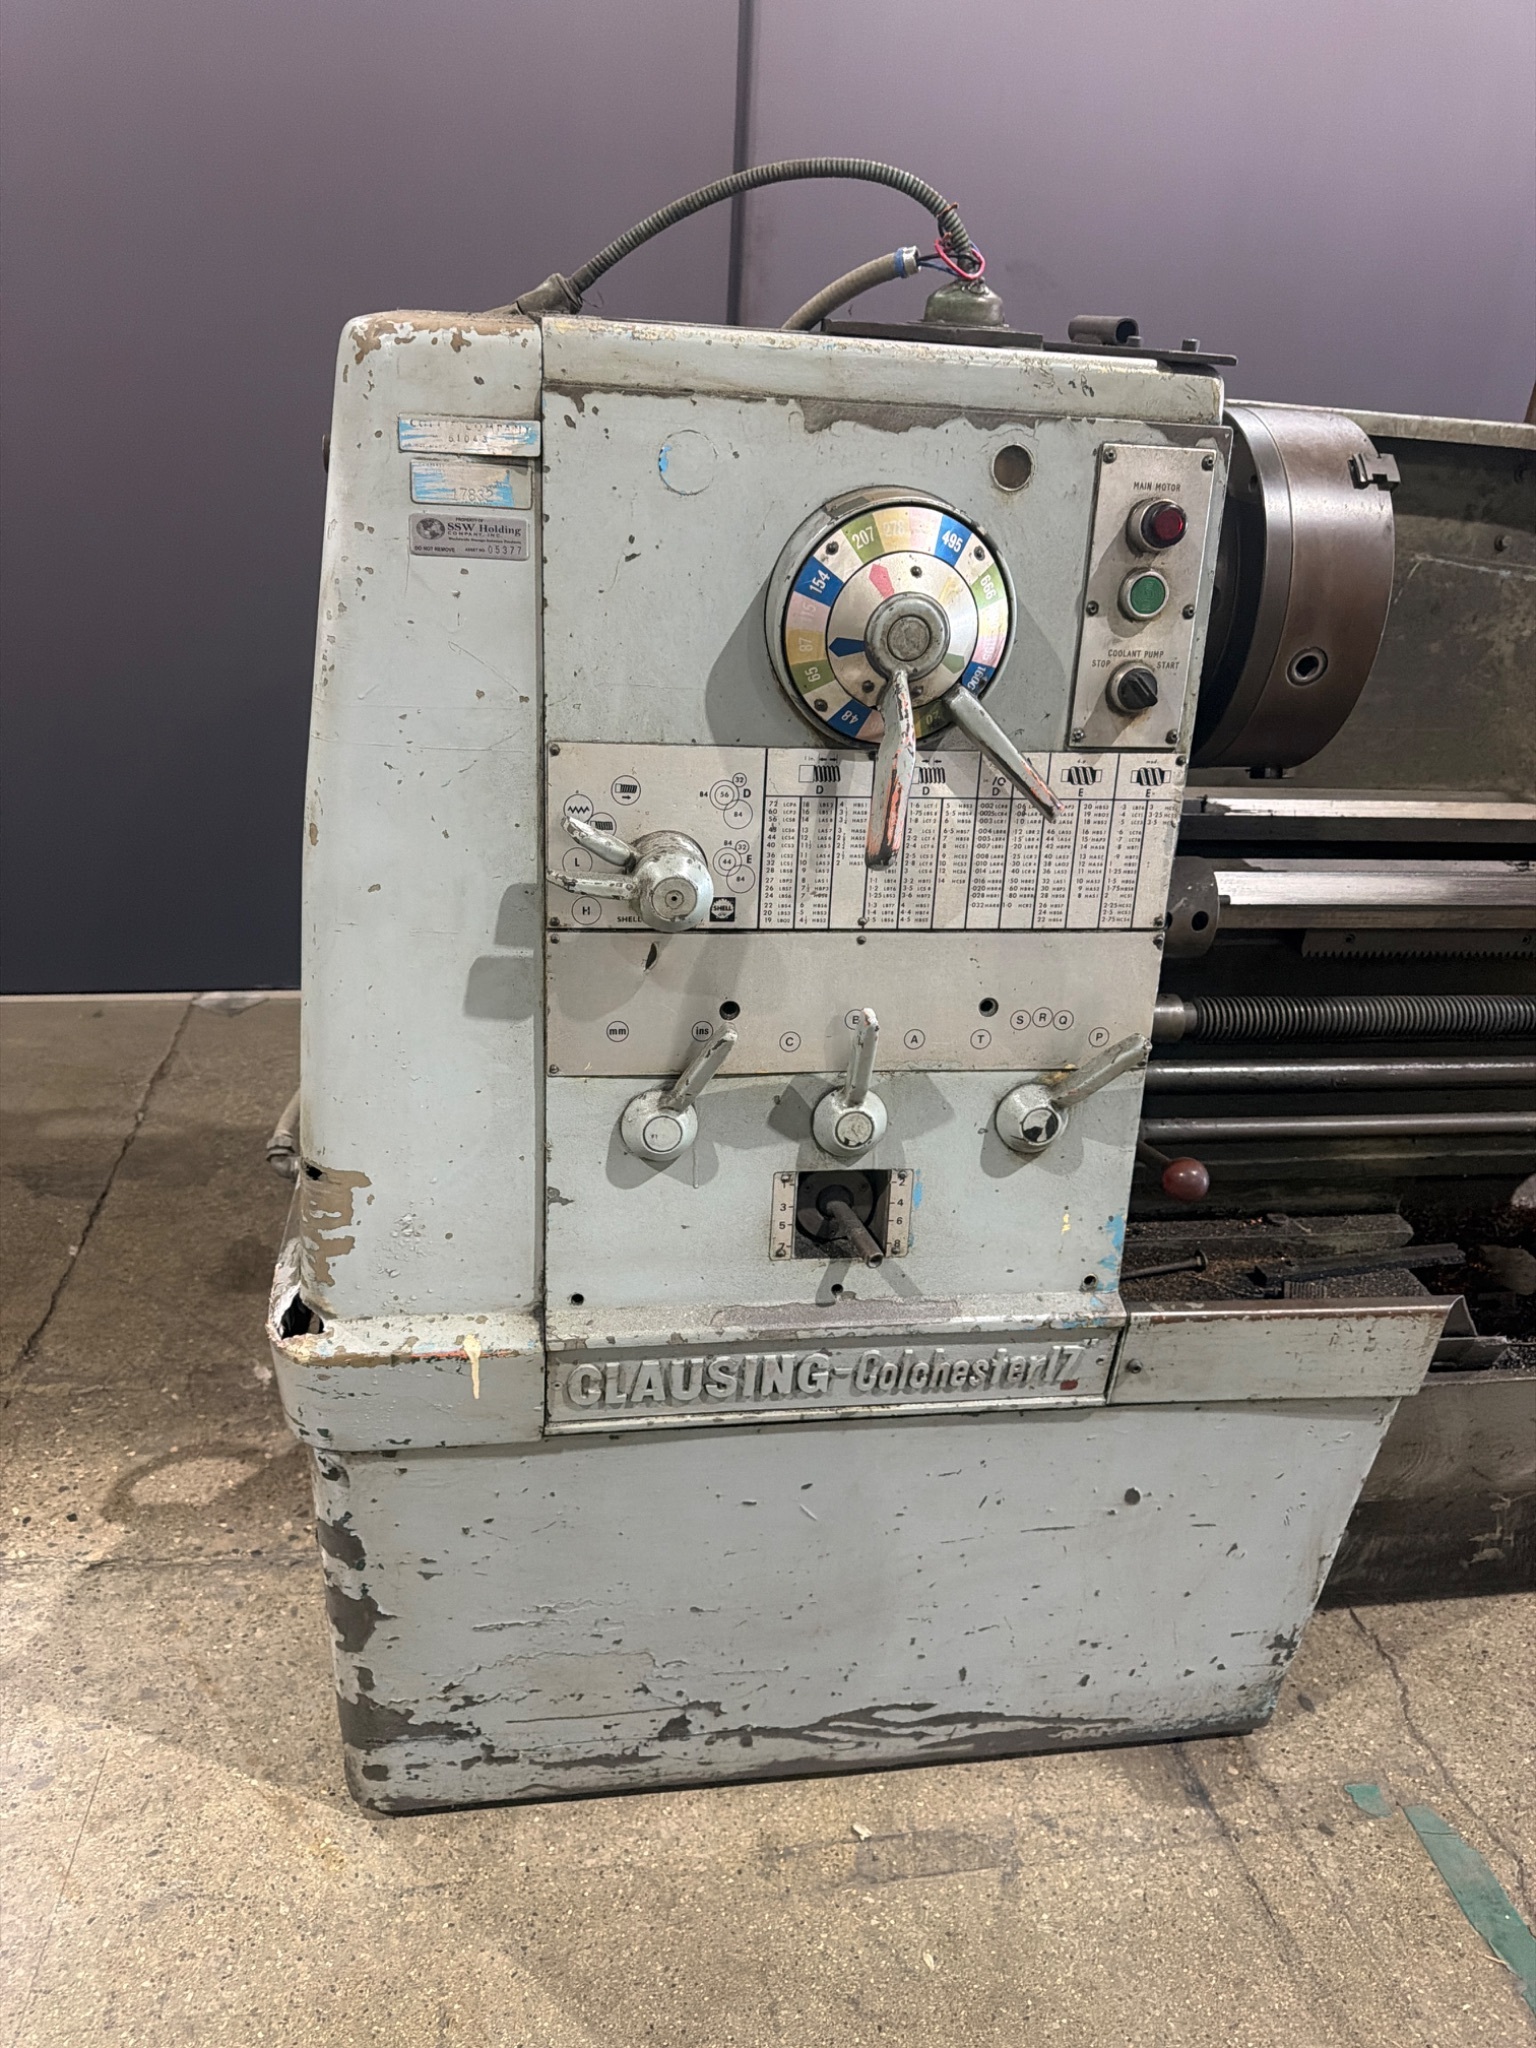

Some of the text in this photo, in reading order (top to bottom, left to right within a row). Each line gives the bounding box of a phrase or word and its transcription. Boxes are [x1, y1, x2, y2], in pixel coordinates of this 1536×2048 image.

[1133, 481, 1181, 492] MAIN MOTOR
[447, 522, 522, 537] SSW Holding
[852, 526, 875, 550] 207
[942, 530, 963, 552] 495
[488, 545, 522, 555] 05377
[809, 569, 831, 594] 154
[980, 574, 997, 600] 666
[799, 637, 813, 652] 87
[1108, 649, 1164, 659] COOLANT PUMP
[1092, 659, 1111, 668] STOP
[1156, 661, 1180, 670] START
[805, 666, 821, 682] 65
[841, 710, 859, 725] 48
[743, 788, 752, 798] D
[816, 785, 824, 794] D
[922, 787, 930, 796] D
[993, 788, 1000, 796] D
[1079, 788, 1084, 797] E
[1145, 789, 1151, 797] E
[574, 857, 580, 867] L
[746, 855, 752, 864] E
[582, 906, 590, 915] H
[852, 1015, 860, 1025] B
[1016, 1015, 1024, 1025] S
[1039, 1012, 1047, 1022] R
[1059, 1015, 1068, 1026] Q
[609, 1027, 627, 1036] mm
[695, 1026, 709, 1036] ins
[785, 1036, 794, 1047] C
[910, 1034, 919, 1044] A
[977, 1034, 985, 1044] T
[1095, 1032, 1104, 1042] P
[899, 1177, 905, 1186] 2
[780, 1203, 787, 1212] 3
[779, 1221, 786, 1229] 5
[896, 1216, 903, 1224] 6
[779, 1242, 785, 1251] 7
[894, 1239, 901, 1248] 8
